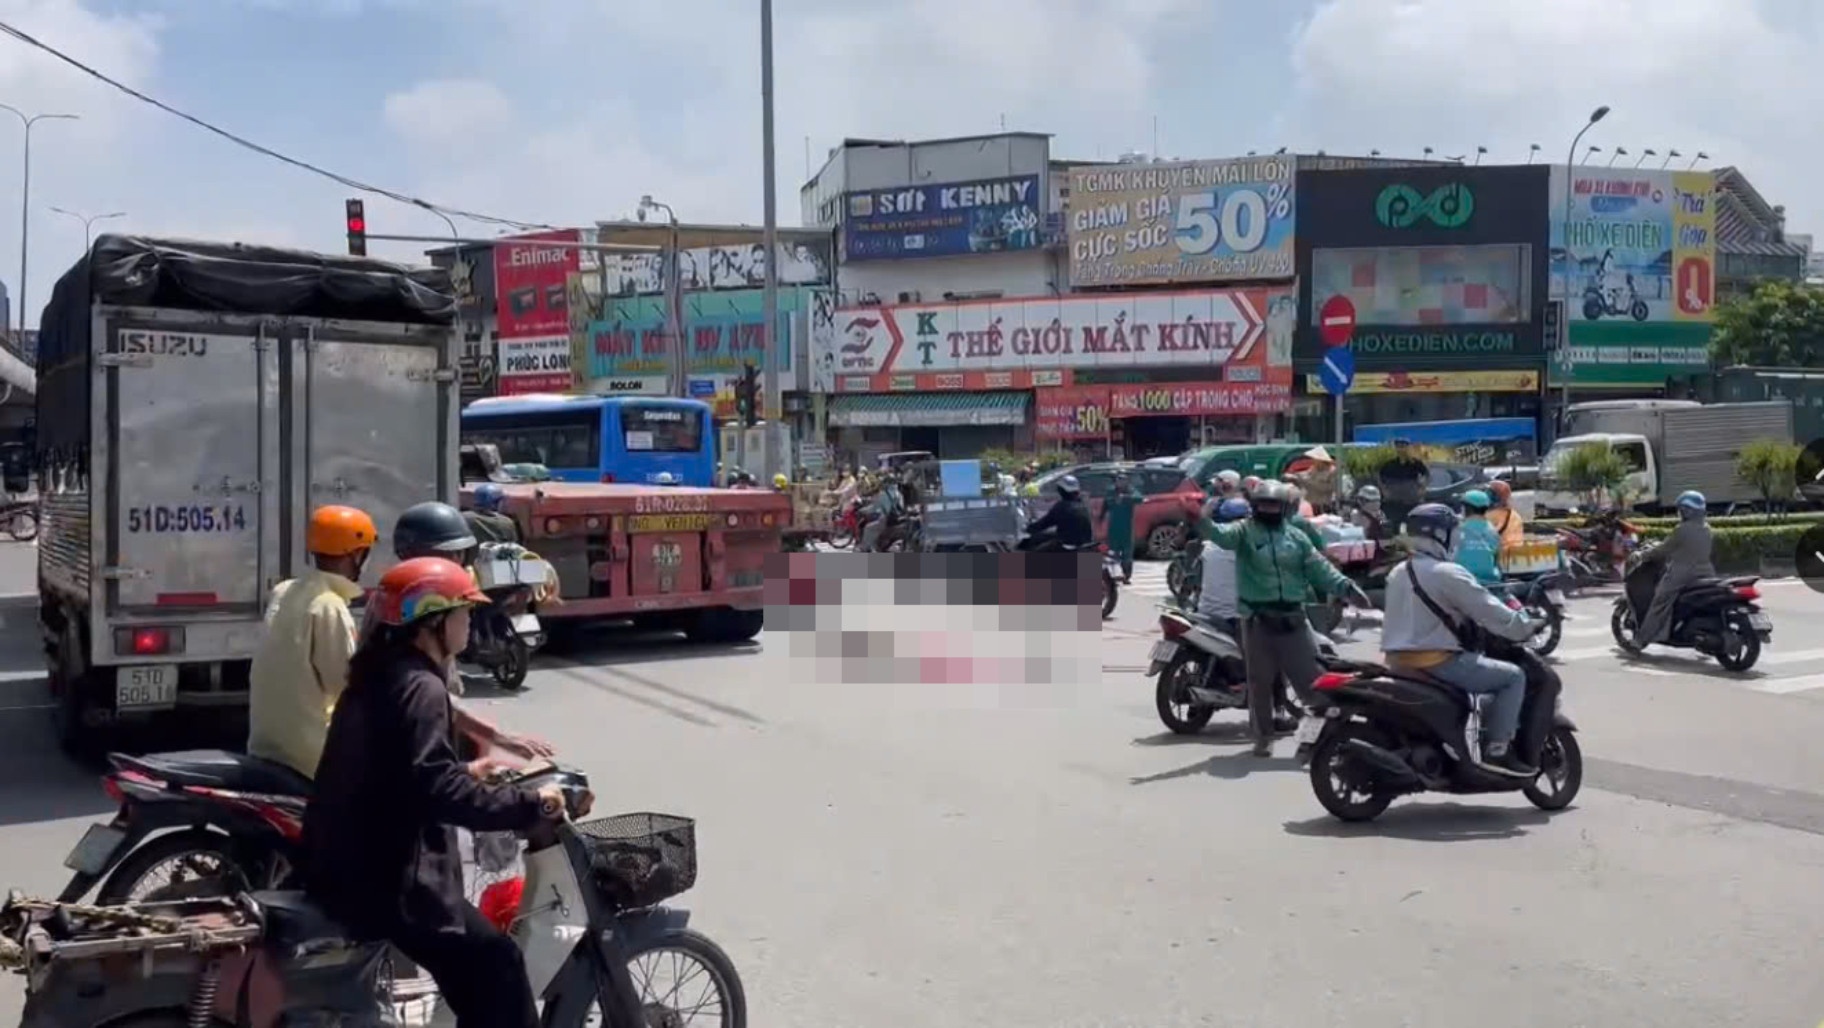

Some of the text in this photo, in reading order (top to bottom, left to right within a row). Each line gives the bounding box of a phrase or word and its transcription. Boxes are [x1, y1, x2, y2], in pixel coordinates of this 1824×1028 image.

[1077, 172, 1125, 192] TGMK
[940, 181, 1031, 210] KENNY
[1135, 189, 1172, 220] GIÁ
[1124, 219, 1169, 252] SỐC
[1601, 221, 1621, 246] XE
[511, 246, 570, 267] Enimac
[120, 332, 207, 357] ISUZU
[947, 310, 1236, 358] THẾ GIỚI MẮT KÍNH
[1348, 333, 1514, 352] HOXEDIEN.COM
[128, 505, 246, 532] 51D:505.14
